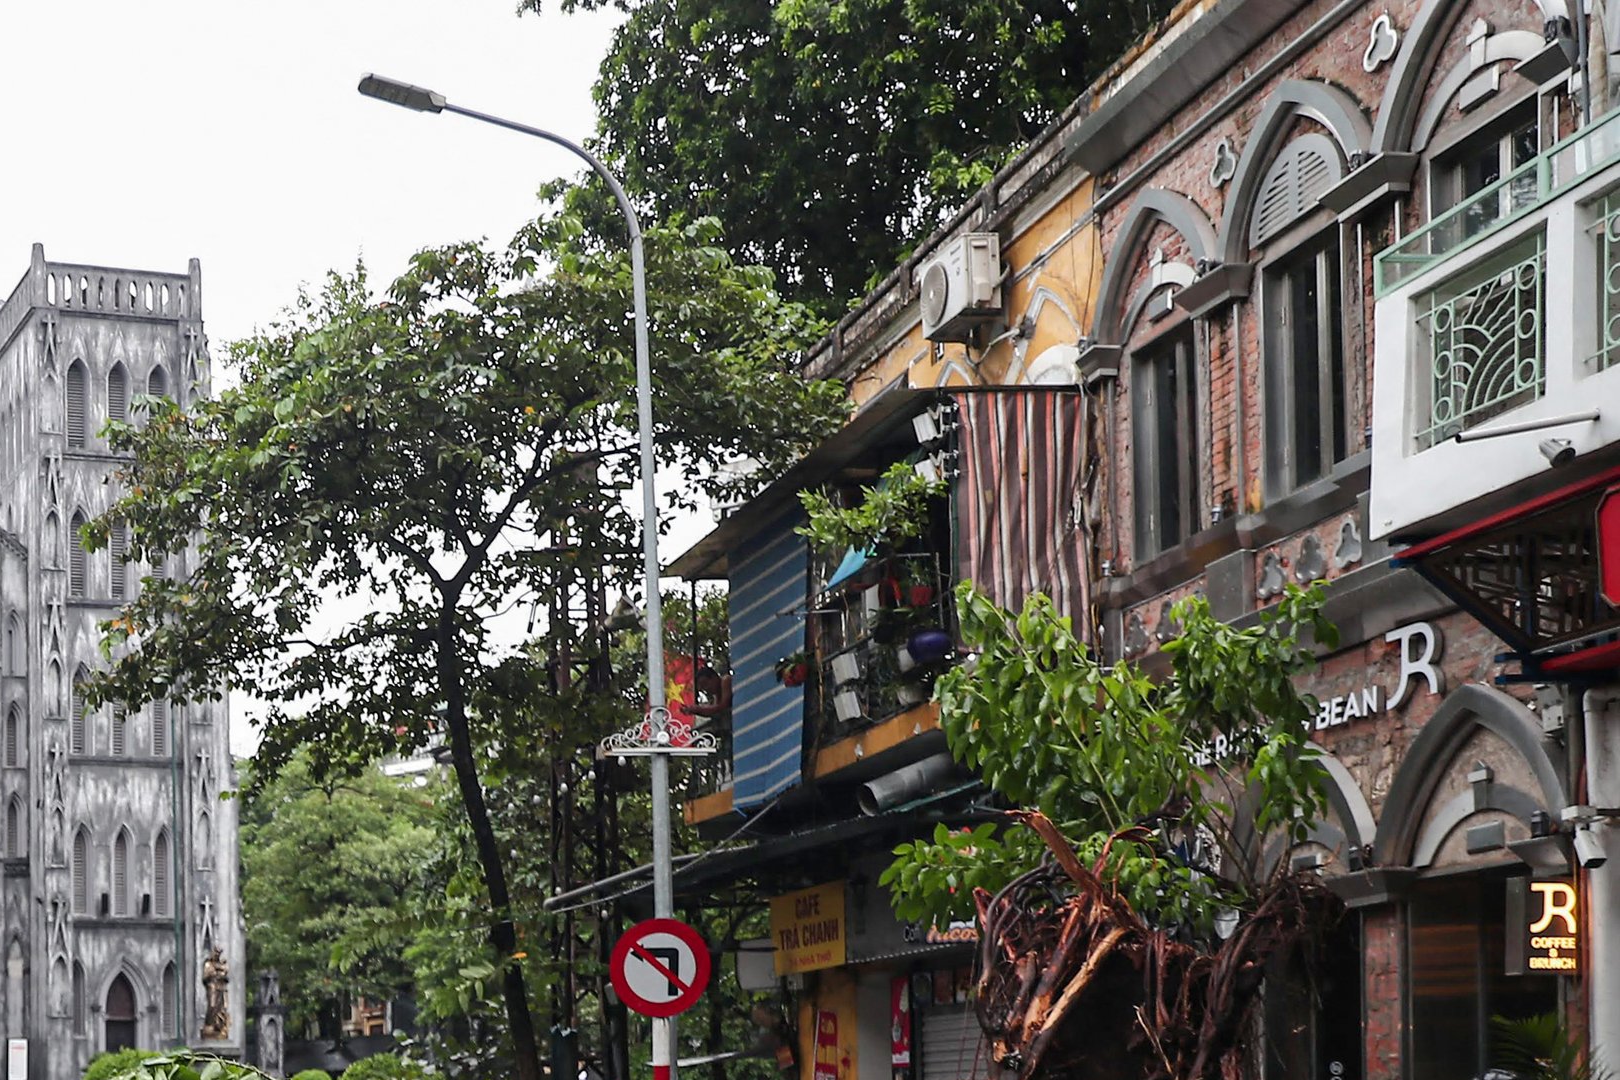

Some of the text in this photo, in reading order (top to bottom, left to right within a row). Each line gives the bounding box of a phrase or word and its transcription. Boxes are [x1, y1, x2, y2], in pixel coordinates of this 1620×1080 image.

[1316, 685, 1378, 730] BEAN
[802, 918, 839, 946] CHANH
[1530, 936, 1576, 949] COFFEE
[1529, 957, 1577, 969] BRUNCH
